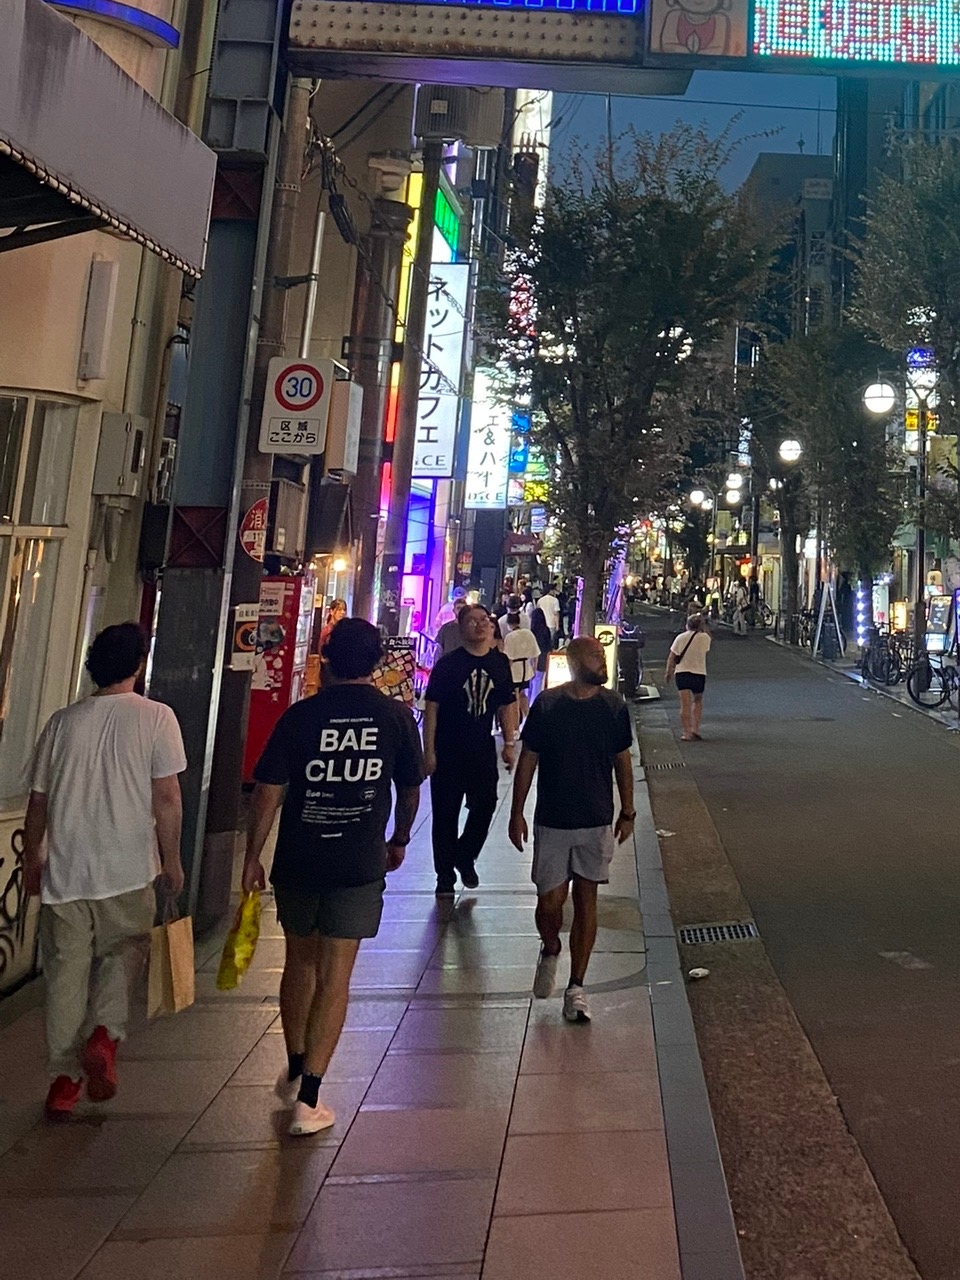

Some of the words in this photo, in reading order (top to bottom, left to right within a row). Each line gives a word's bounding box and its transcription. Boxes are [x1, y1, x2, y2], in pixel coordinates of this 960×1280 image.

[418, 277, 449, 443] ネットカフェ
[285, 376, 313, 398] 30
[280, 420, 309, 432] 区域
[270, 432, 317, 445] ここから
[599, 634, 614, 644] 2F
[320, 727, 379, 752] BAE
[305, 758, 384, 782] CLUB
